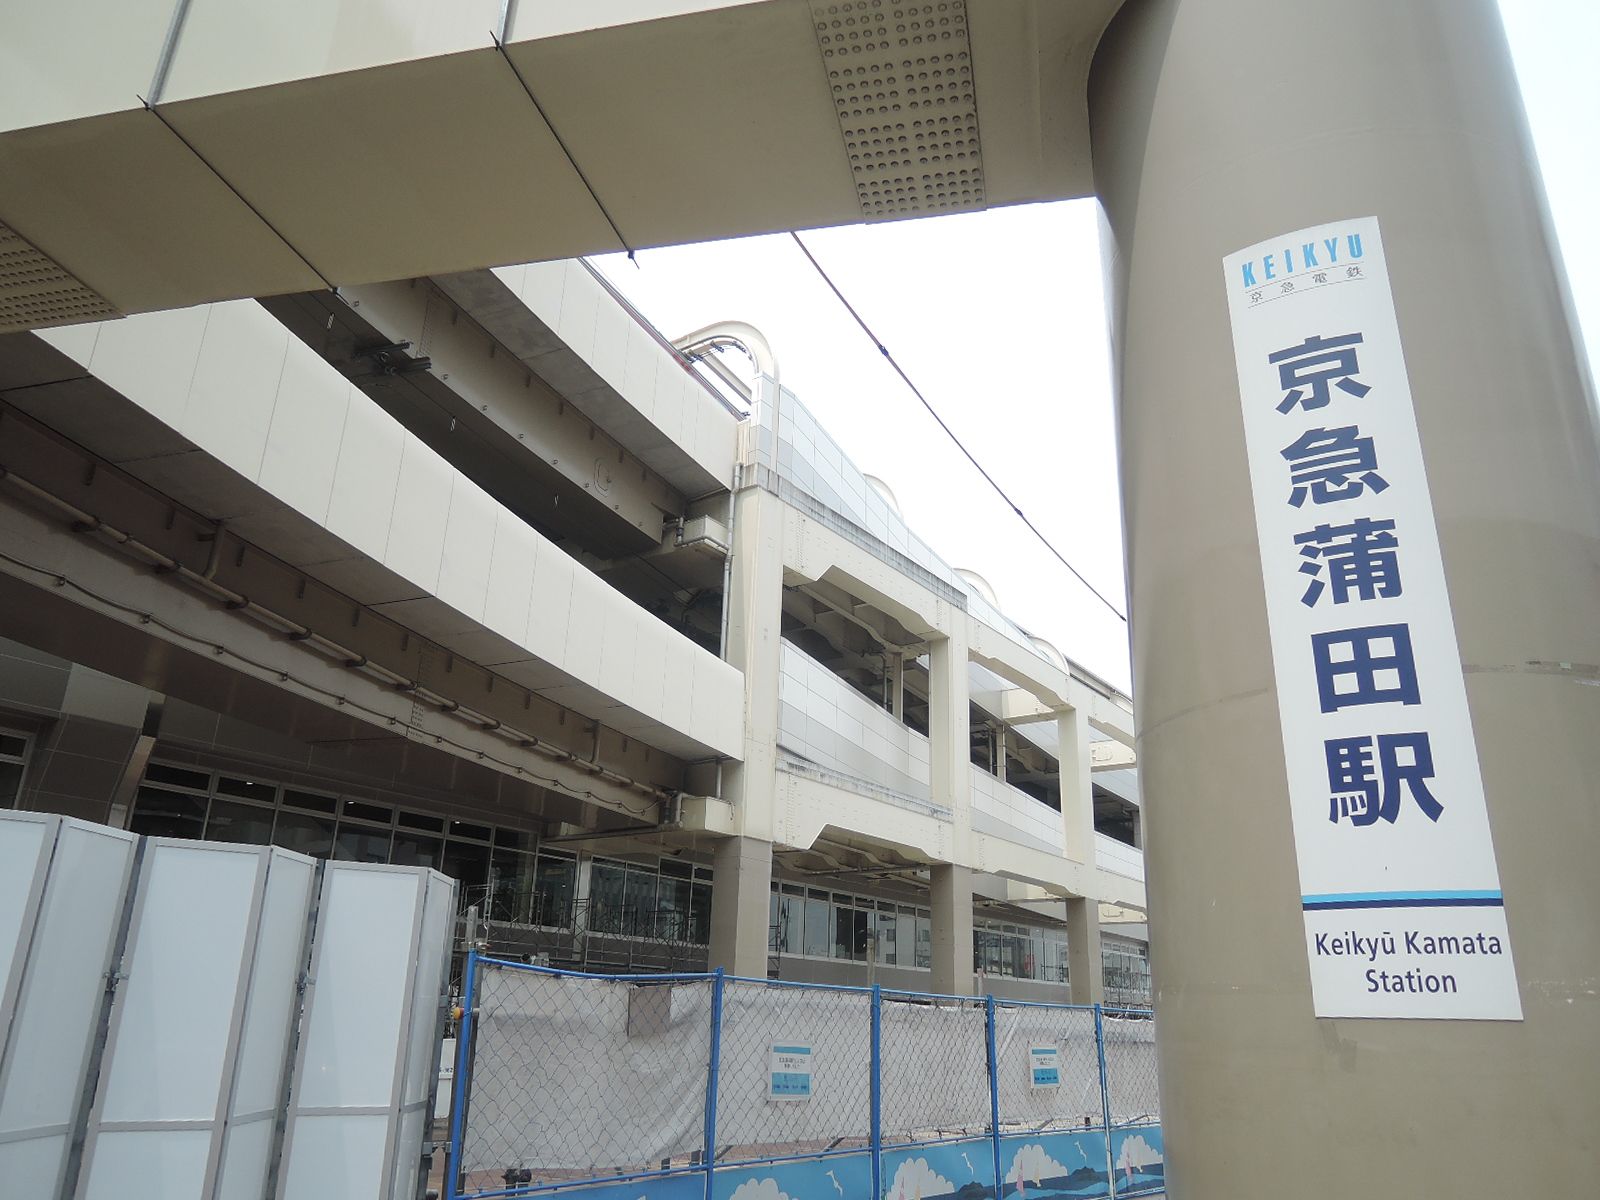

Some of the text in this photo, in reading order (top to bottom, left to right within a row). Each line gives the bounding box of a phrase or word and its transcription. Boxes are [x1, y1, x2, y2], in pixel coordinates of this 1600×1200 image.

[1241, 233, 1364, 288] KEIKYU
[1249, 265, 1364, 304] 京急電鉄
[1268, 332, 1445, 827] 京急蒲田駅
[1315, 931, 1502, 962] Keikyū Kamata
[1365, 968, 1458, 993] Station
